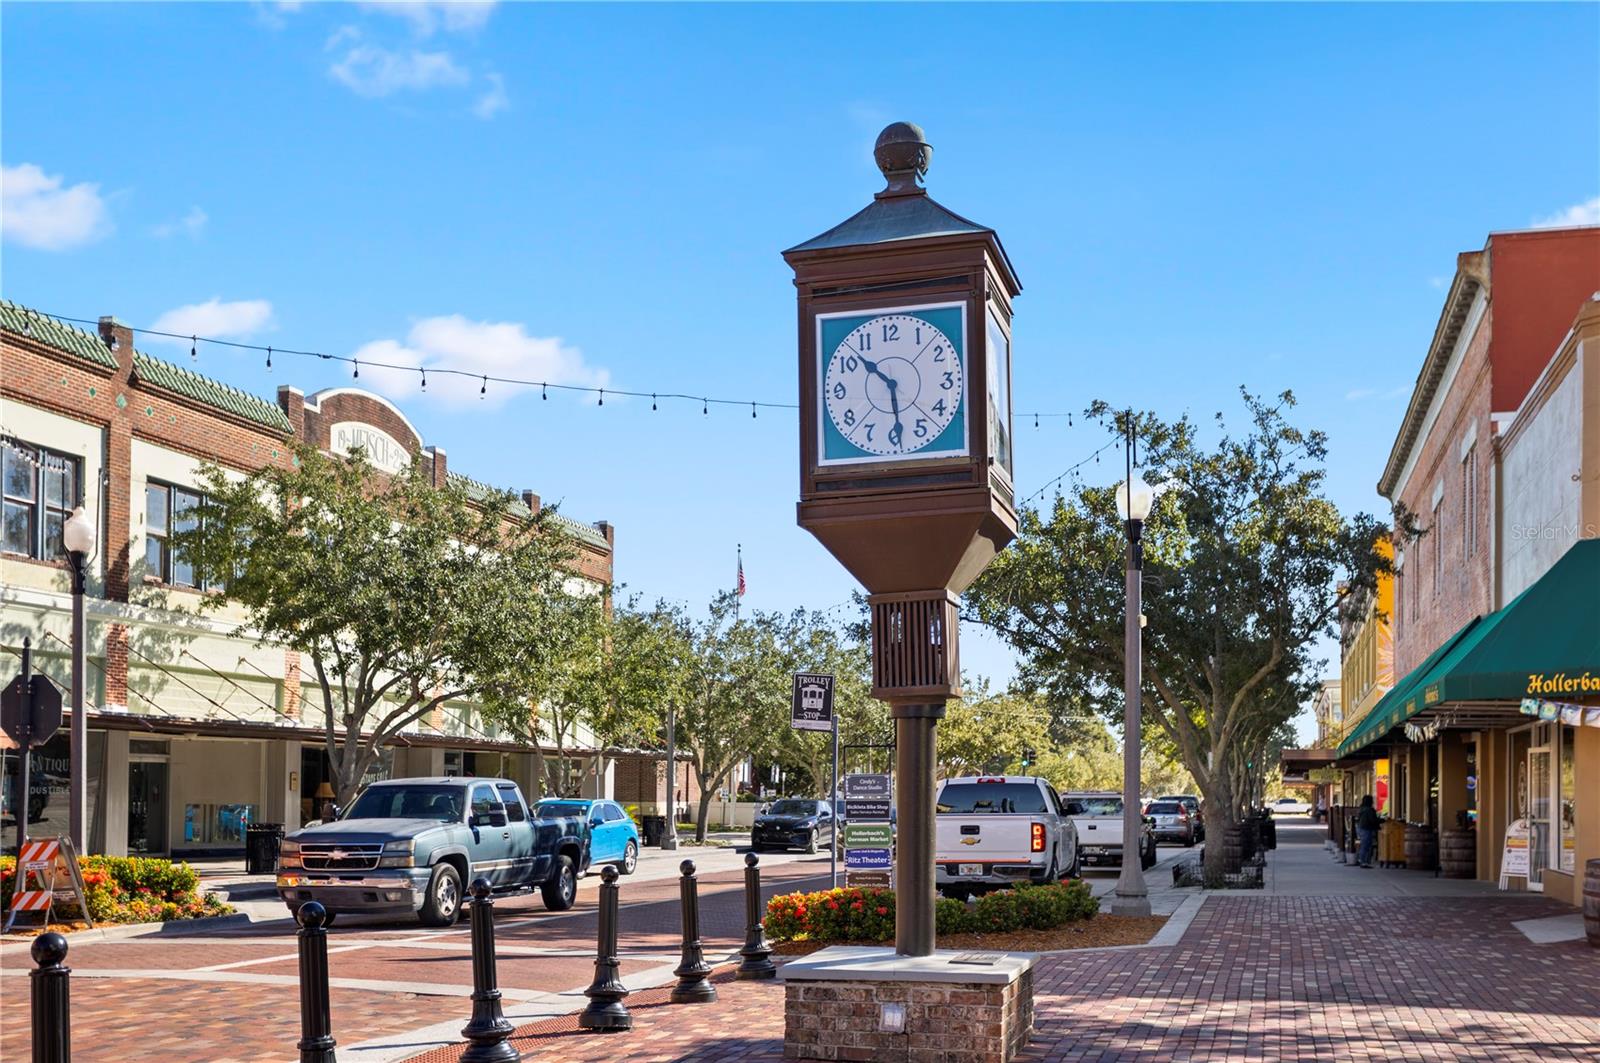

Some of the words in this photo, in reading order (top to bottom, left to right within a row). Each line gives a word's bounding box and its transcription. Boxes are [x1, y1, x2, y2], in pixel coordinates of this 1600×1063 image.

[859, 332, 871, 351] 11
[882, 324, 900, 342] 12
[915, 326, 921, 345] 1
[933, 345, 945, 363] 2
[840, 355, 858, 374] 10
[939, 371, 954, 390] 3
[833, 381, 846, 400] 9
[931, 398, 947, 417] 4
[843, 408, 856, 427] 8
[864, 423, 876, 442] 7
[888, 427, 901, 447] 6
[913, 418, 928, 438] 5
[797, 676, 831, 690] TROLLEY
[803, 711, 821, 721] STOP
[30, 753, 70, 772] ANTIQU
